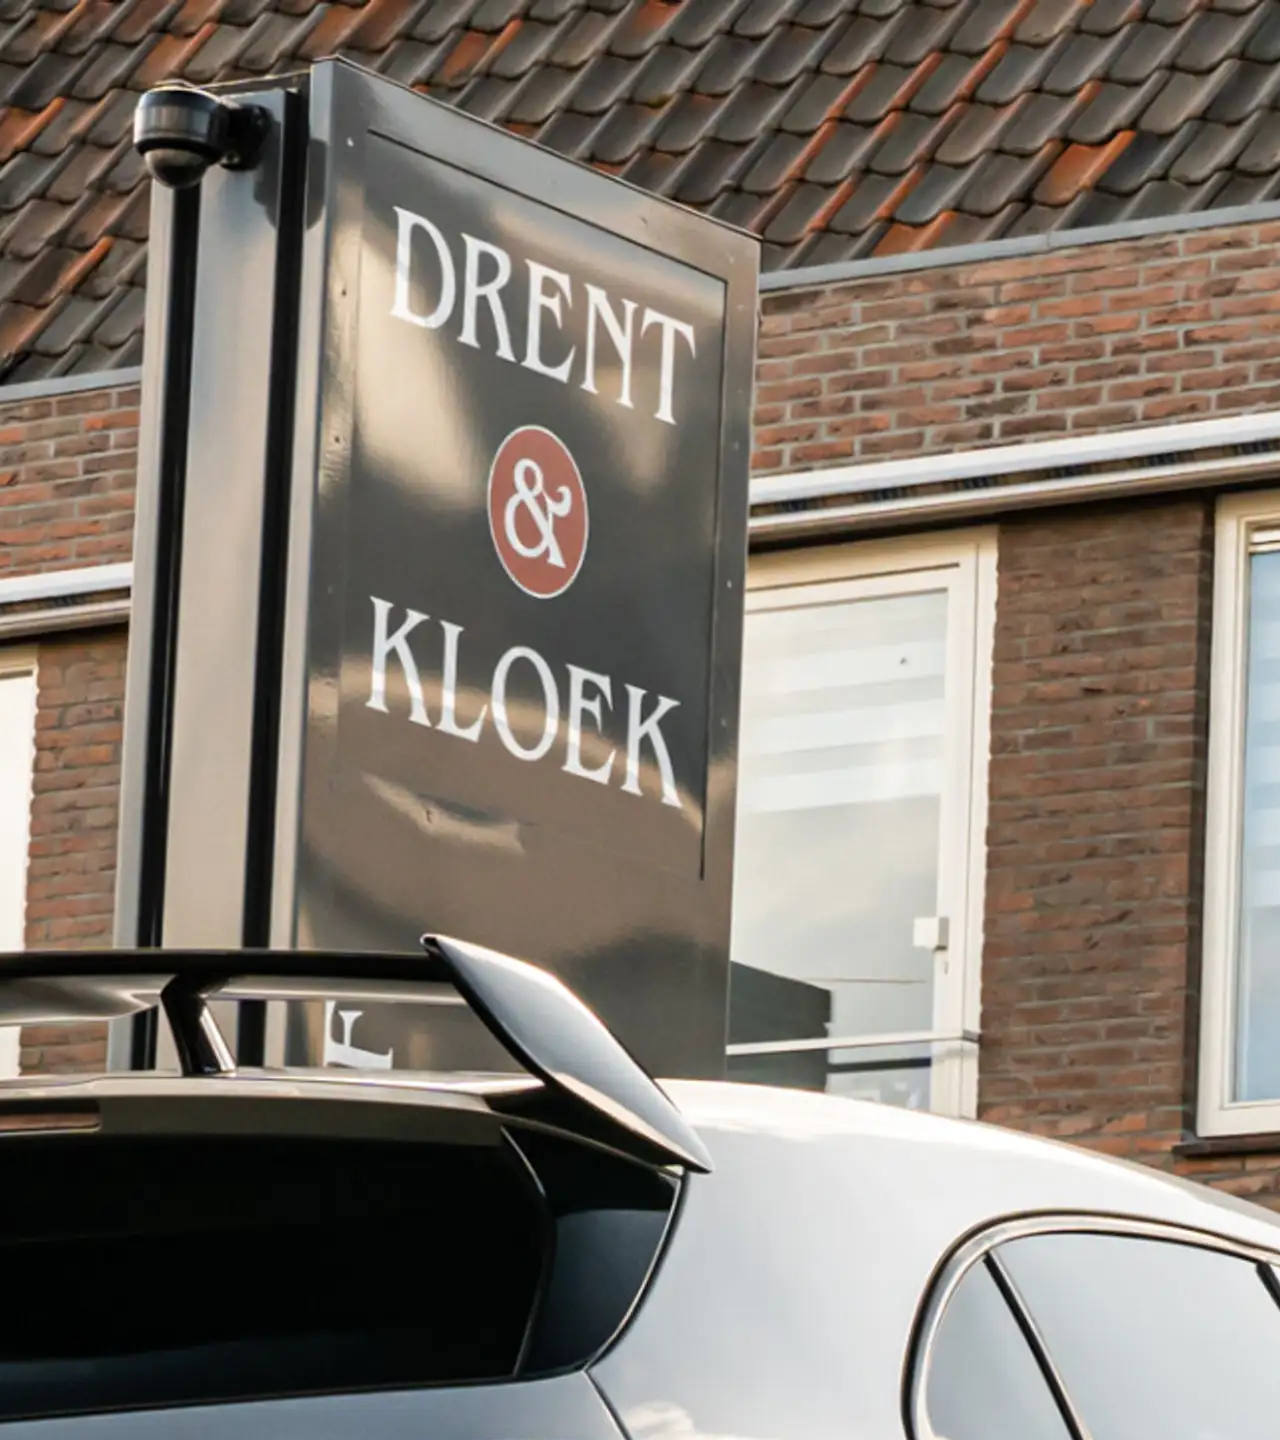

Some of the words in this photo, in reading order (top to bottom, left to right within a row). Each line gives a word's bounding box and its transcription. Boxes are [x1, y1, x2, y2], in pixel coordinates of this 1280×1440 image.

[389, 204, 698, 426] DRENT
[503, 457, 573, 569] &
[364, 595, 683, 809] KLOEK
